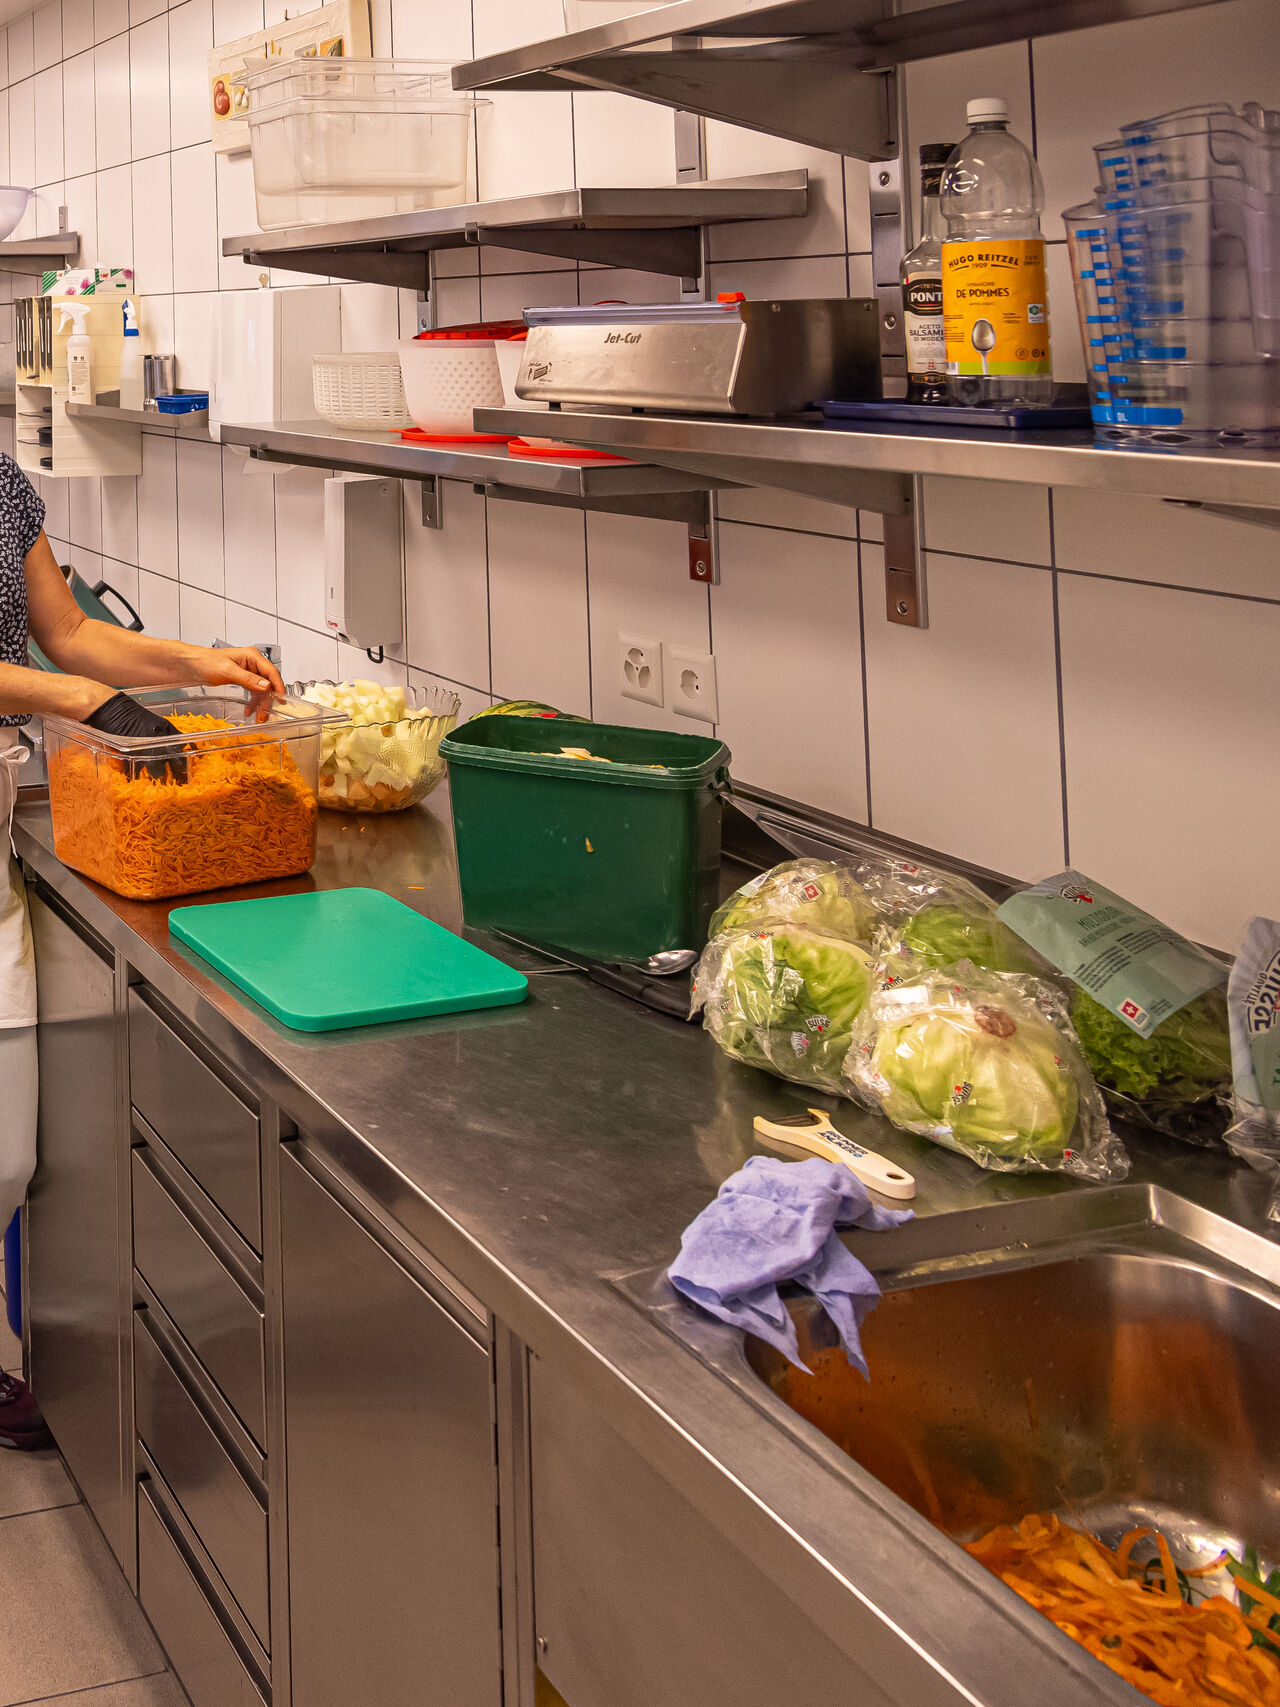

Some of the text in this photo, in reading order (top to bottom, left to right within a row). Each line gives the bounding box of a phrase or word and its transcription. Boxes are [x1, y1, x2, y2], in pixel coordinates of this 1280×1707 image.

[948, 254, 975, 268] HUGO
[977, 253, 1019, 266] REITZEL
[910, 291, 943, 302] PONT
[956, 287, 1010, 298] DE POMMES
[604, 332, 642, 344] Jet-Cut
[909, 329, 944, 337] BALSAMI
